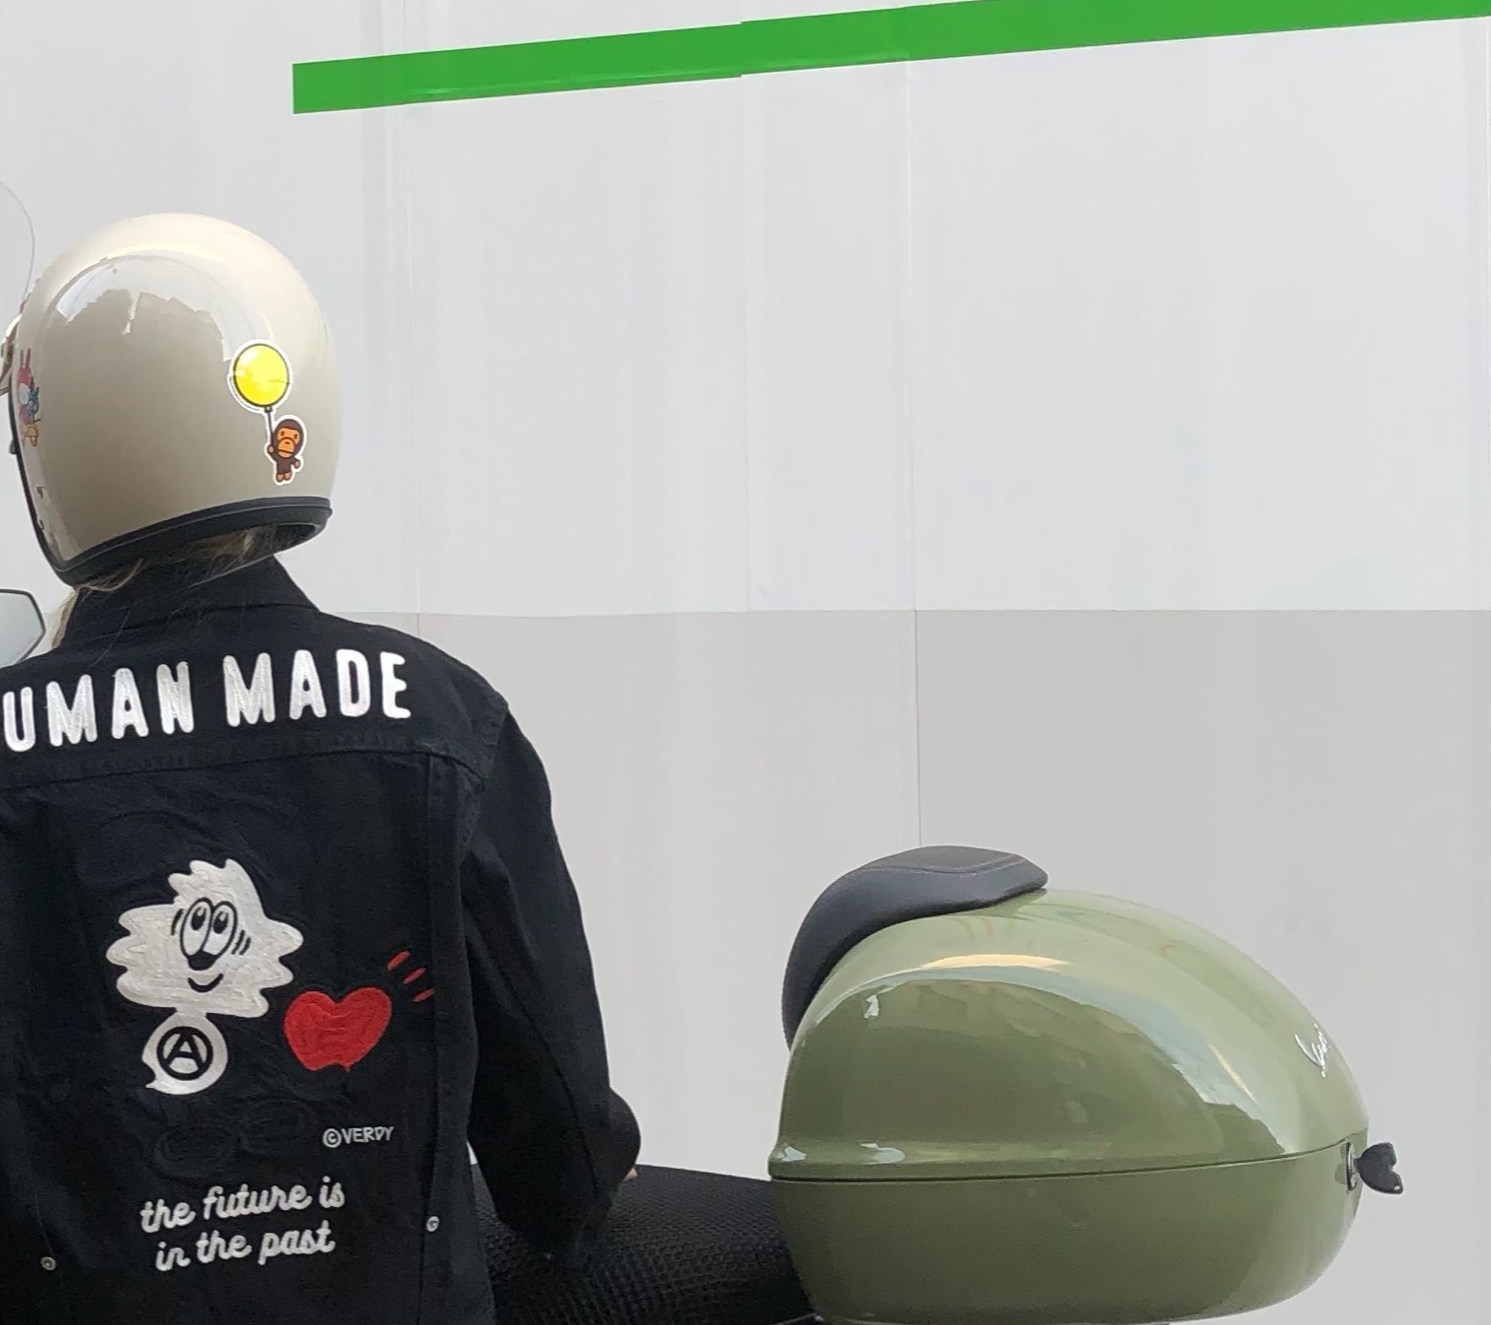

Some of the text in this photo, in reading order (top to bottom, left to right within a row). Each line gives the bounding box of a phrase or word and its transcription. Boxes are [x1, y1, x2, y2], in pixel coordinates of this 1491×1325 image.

[222, 648, 412, 728] MADE
[140, 1175, 346, 1233] the future is
[155, 1219, 337, 1272] in the past
